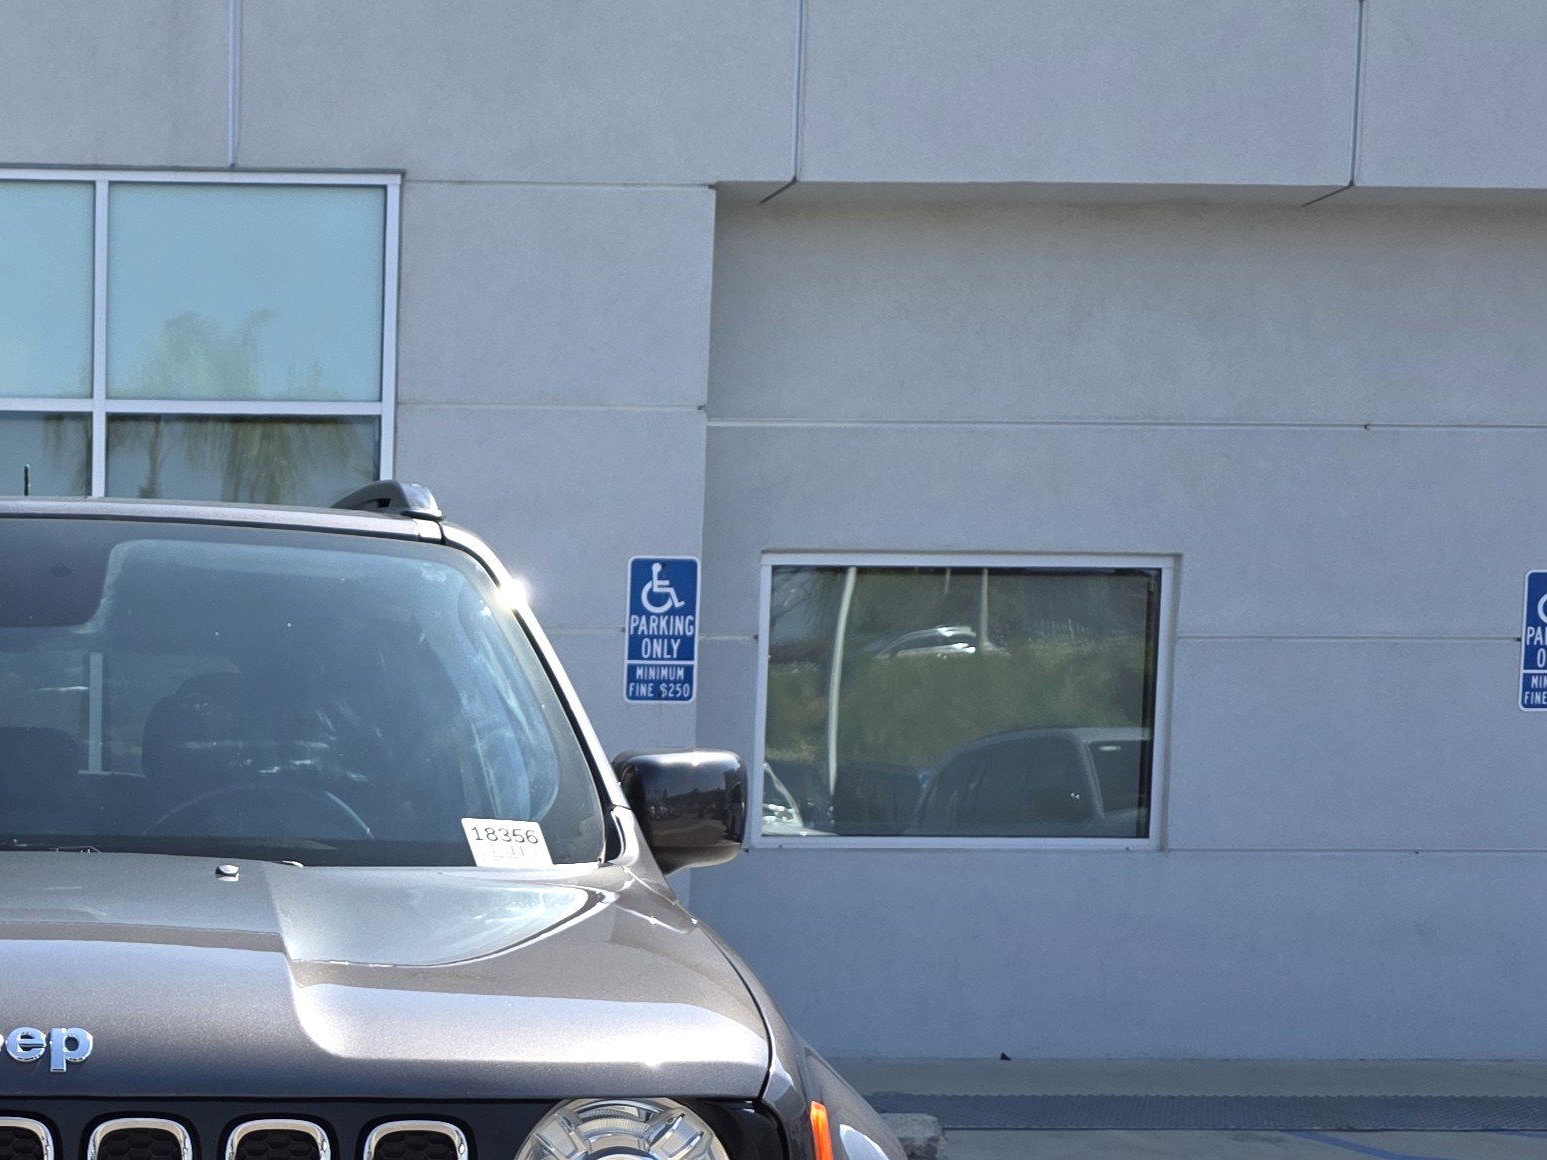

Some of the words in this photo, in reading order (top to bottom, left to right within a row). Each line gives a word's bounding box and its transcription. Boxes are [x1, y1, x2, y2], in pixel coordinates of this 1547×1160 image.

[629, 615, 694, 636] PARKING
[641, 638, 681, 658] ONLY
[636, 666, 684, 680] MINIMUM
[628, 683, 654, 697] FINE
[659, 683, 690, 698] $250
[472, 826, 539, 844] 18356
